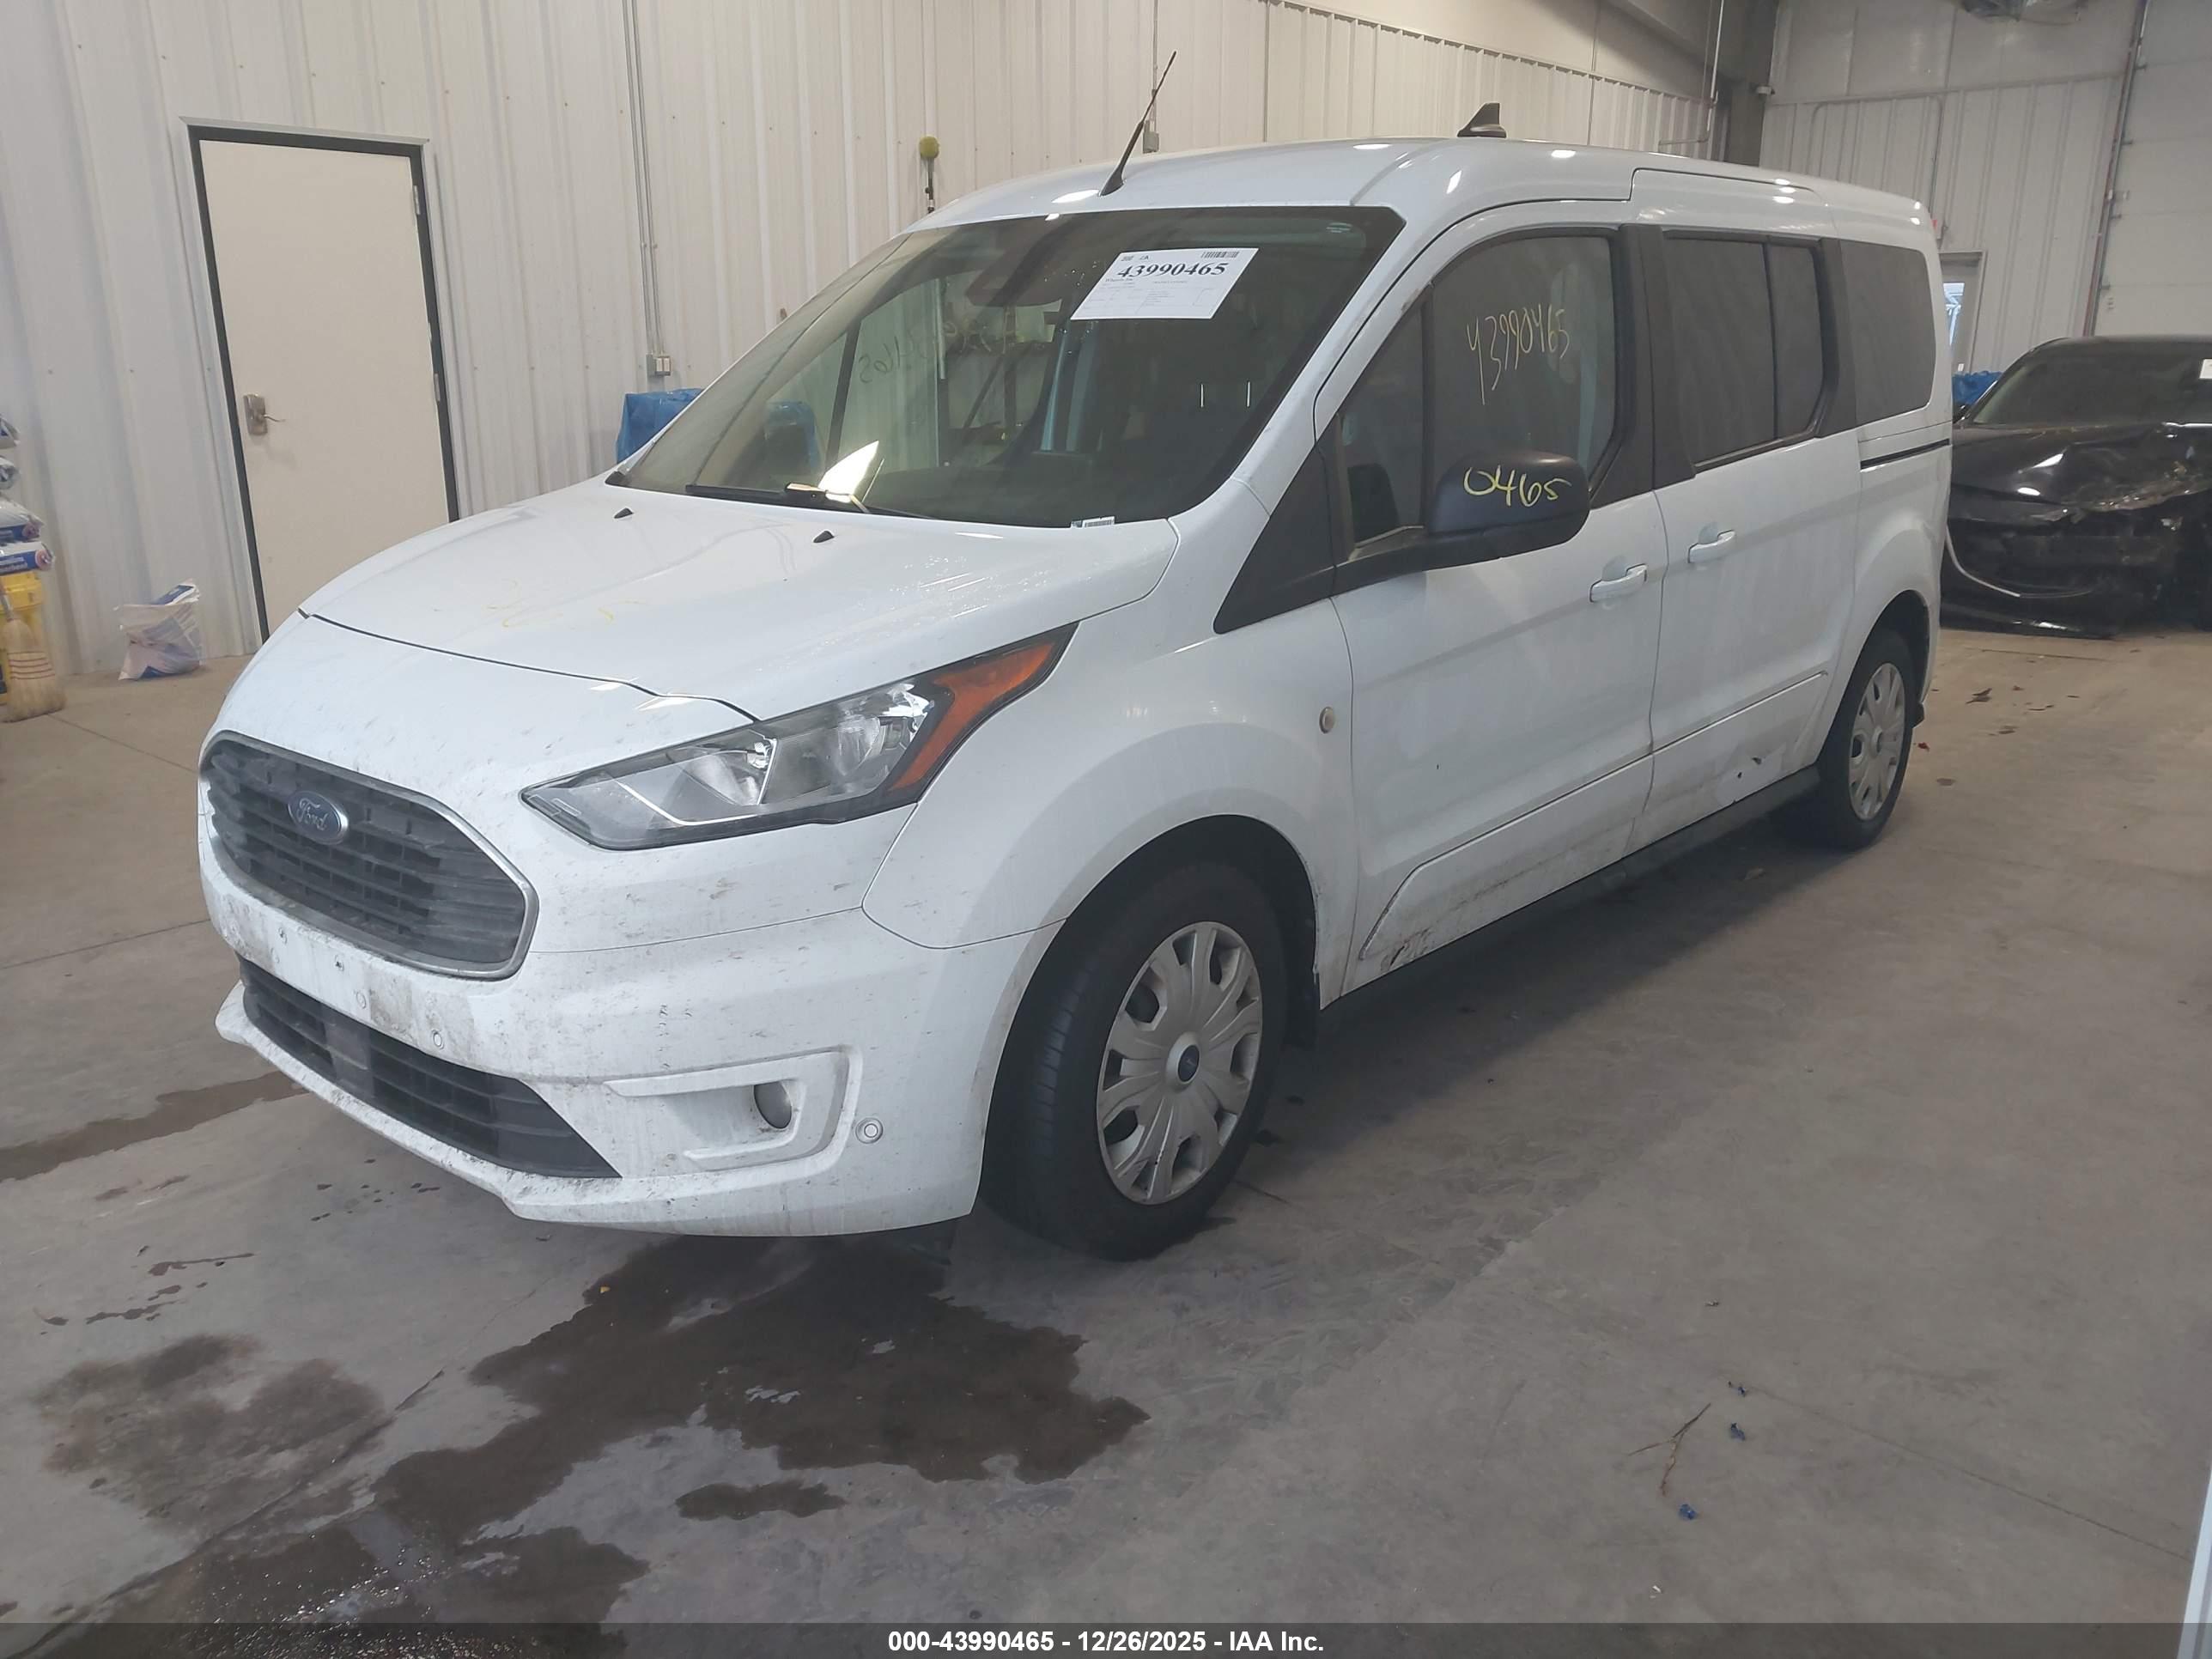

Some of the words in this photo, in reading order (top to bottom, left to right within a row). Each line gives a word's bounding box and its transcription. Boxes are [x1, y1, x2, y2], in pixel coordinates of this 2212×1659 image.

[1117, 262, 1230, 278] 43990465
[1466, 303, 1571, 406] 43990465
[1462, 465, 1572, 507] 0465
[296, 798, 329, 831] Ford
